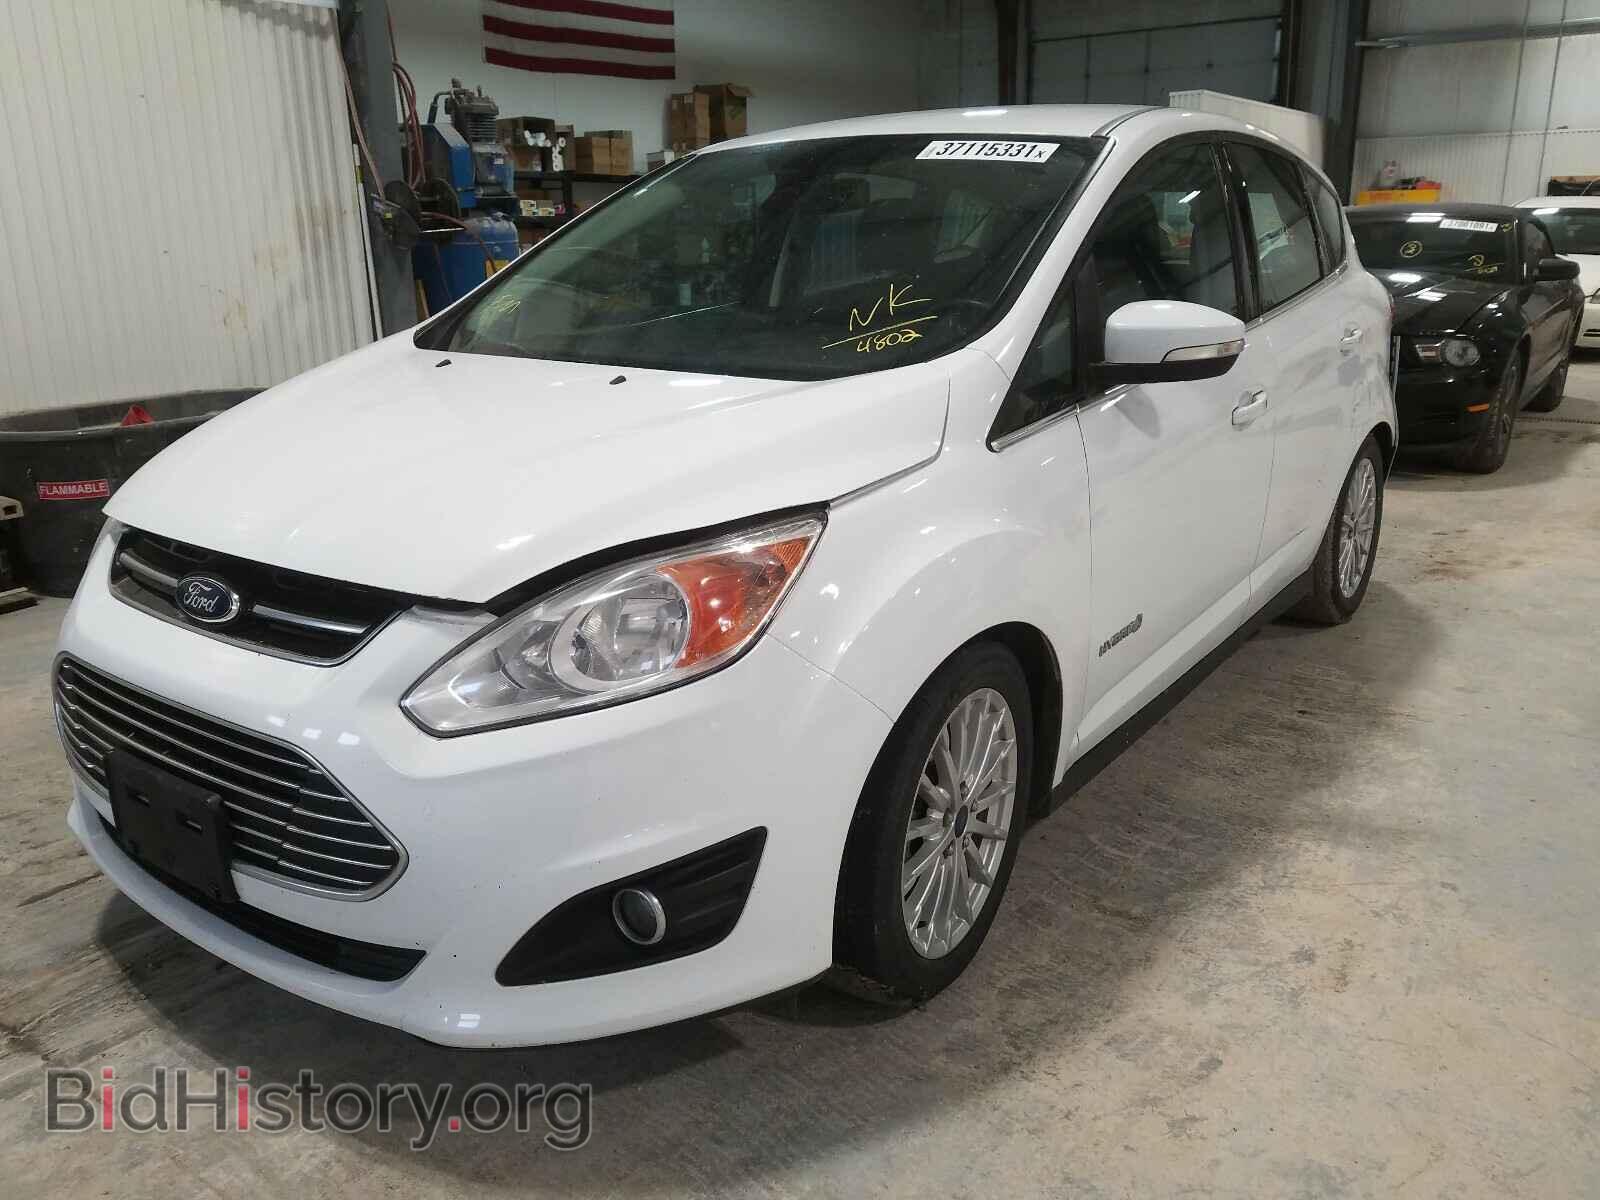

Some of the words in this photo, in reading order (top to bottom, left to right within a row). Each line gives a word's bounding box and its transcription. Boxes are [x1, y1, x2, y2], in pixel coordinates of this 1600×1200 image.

[856, 328, 923, 353] 4802
[39, 482, 107, 495] FLAMMABLE
[183, 581, 220, 613] Ford
